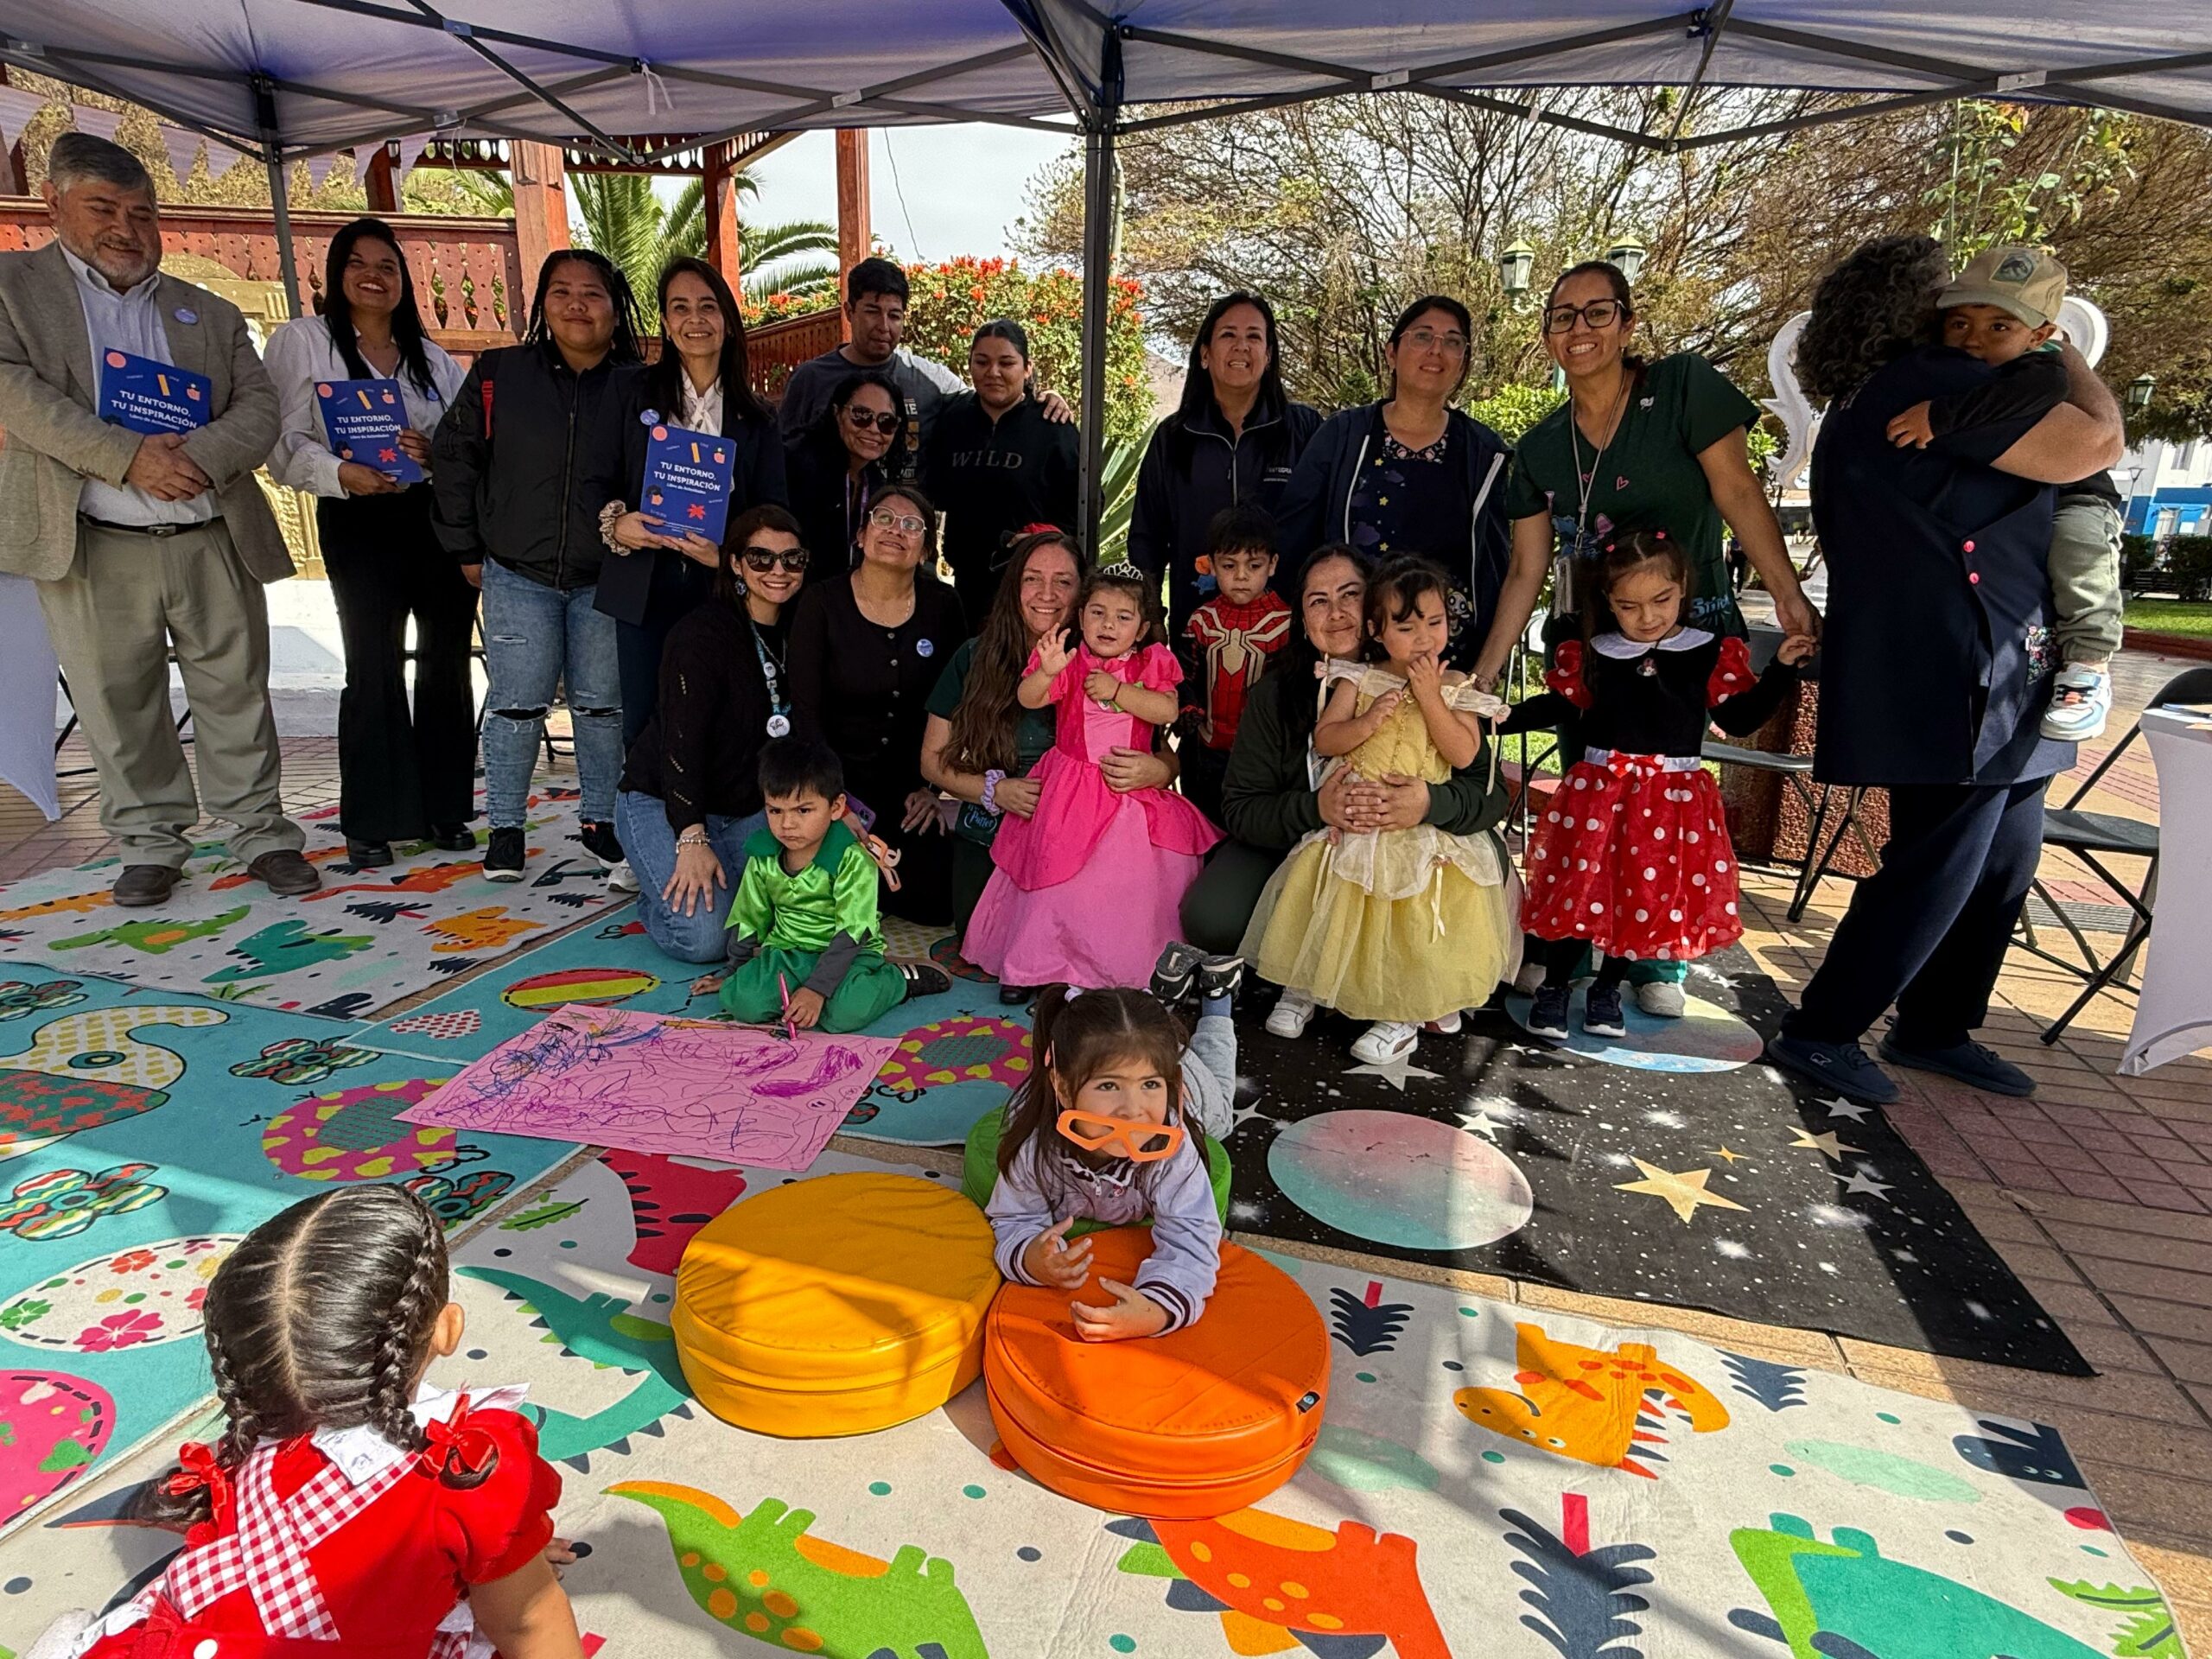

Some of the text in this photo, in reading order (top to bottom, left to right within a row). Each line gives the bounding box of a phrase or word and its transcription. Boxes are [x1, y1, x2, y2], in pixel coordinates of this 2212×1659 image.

[119, 390, 192, 416] TU ENTORNO,
[111, 399, 198, 429] TU INSPIRACIÓN
[350, 415, 394, 423] ENTORNO,
[347, 424, 401, 434] INSPIRACIÓN
[951, 450, 1022, 469] WILD
[660, 461, 716, 480] TU ENTORNO,
[653, 471, 721, 492] TU INSPIRACIÓN
